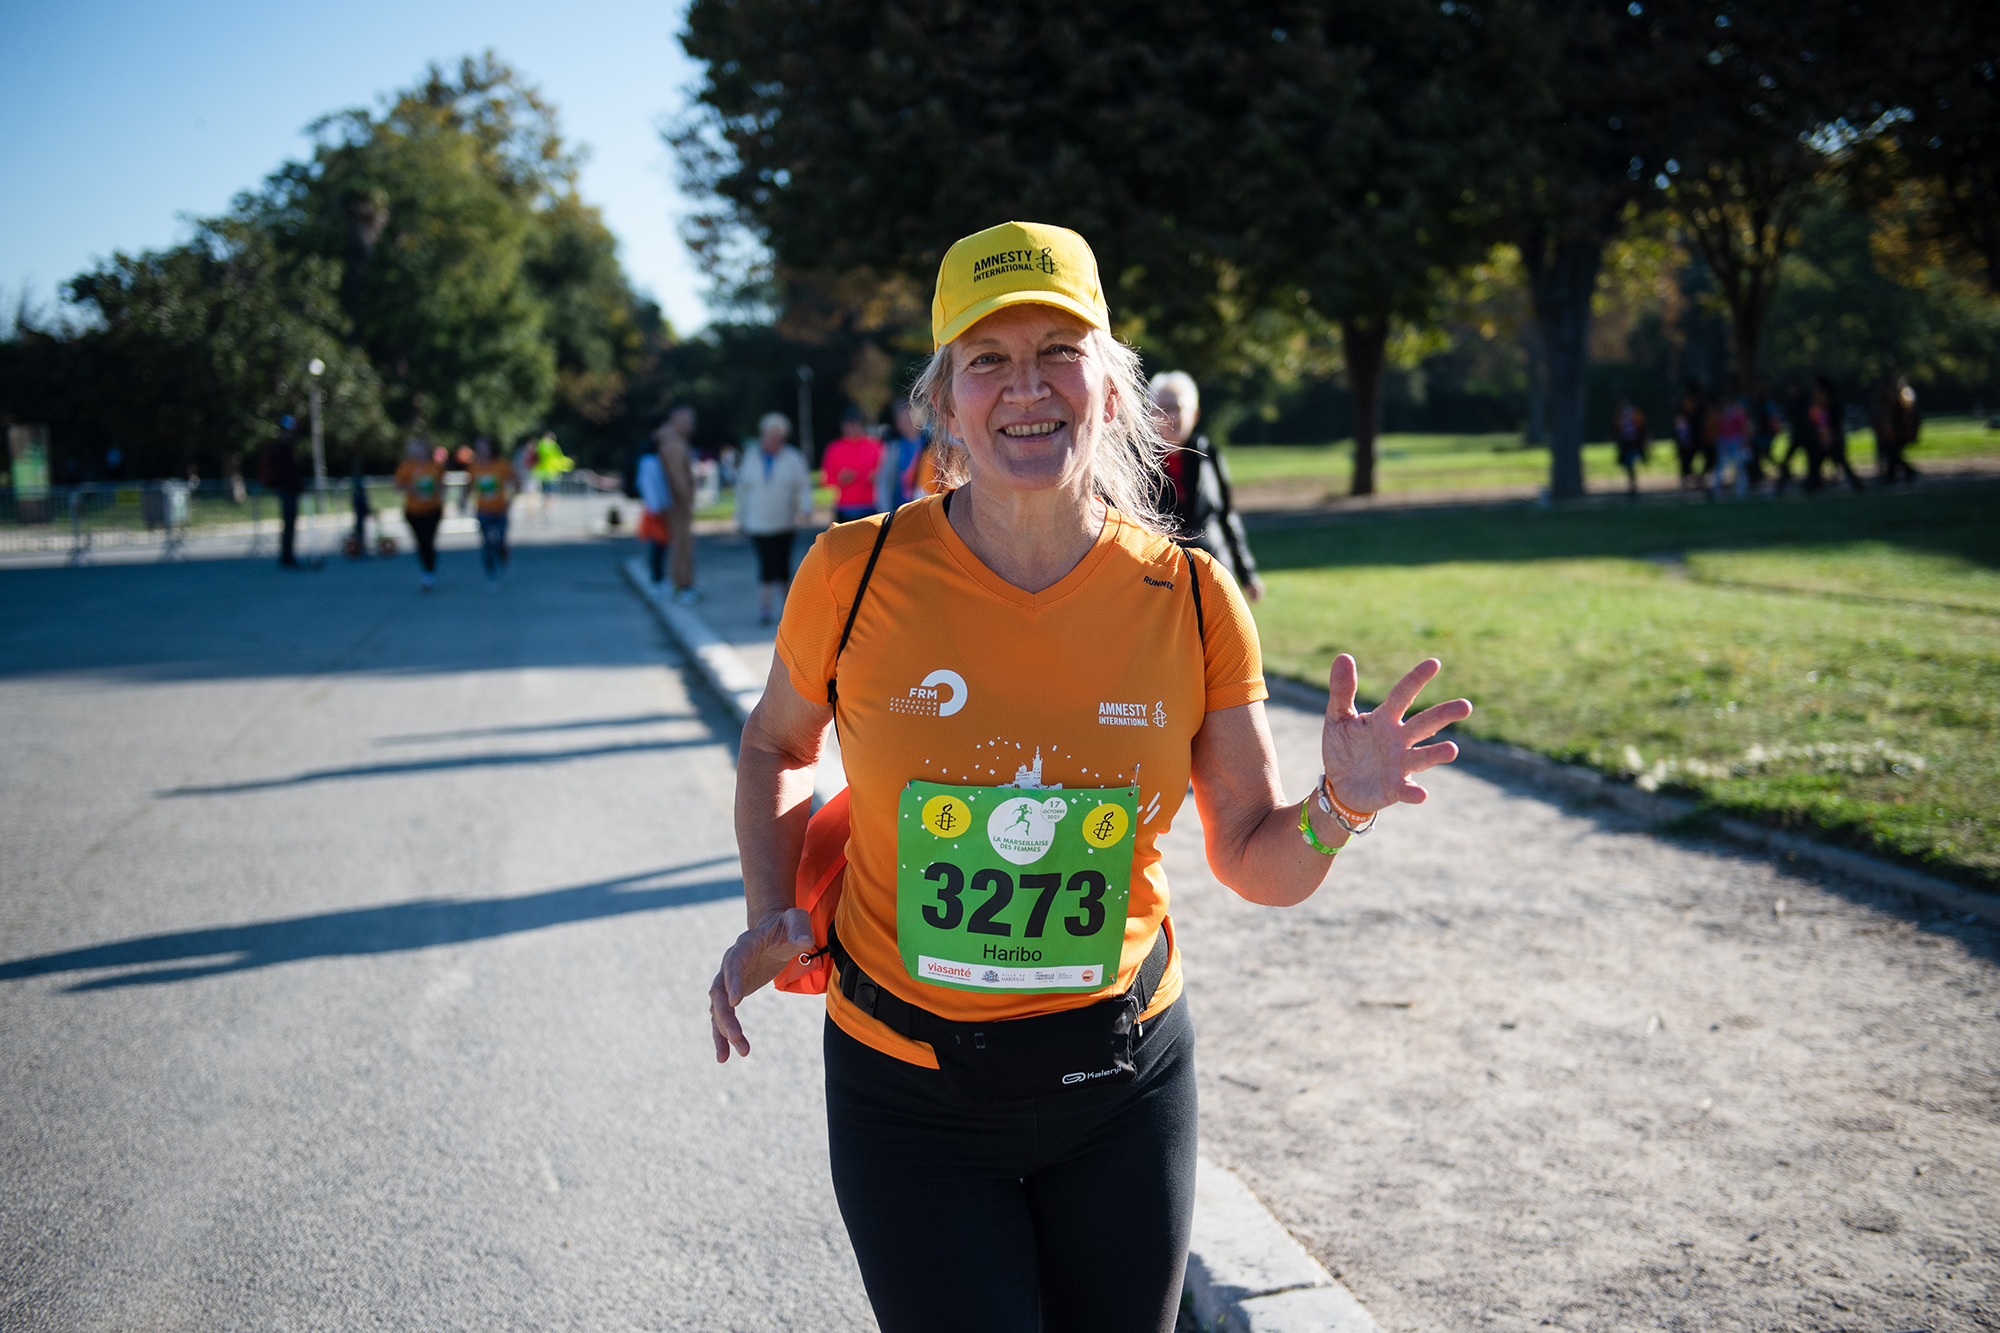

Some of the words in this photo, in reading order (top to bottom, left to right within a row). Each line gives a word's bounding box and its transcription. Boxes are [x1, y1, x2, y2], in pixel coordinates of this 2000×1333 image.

[974, 250, 1032, 274] AMNESTY
[974, 264, 1034, 283] INTERNATIONAL
[909, 687, 938, 700] FRM
[890, 697, 937, 706] FONDATION
[890, 702, 937, 711] RECHERCHE
[1098, 702, 1147, 717] AMNESTY
[1098, 716, 1149, 727] INTERNATIONAL
[1003, 838, 1048, 846] MARSEILLAISE
[922, 862, 1106, 938] 3273
[983, 944, 1042, 961] Haribo
[928, 963, 971, 978] viasanté
[1087, 1064, 1121, 1079] Kalenji
